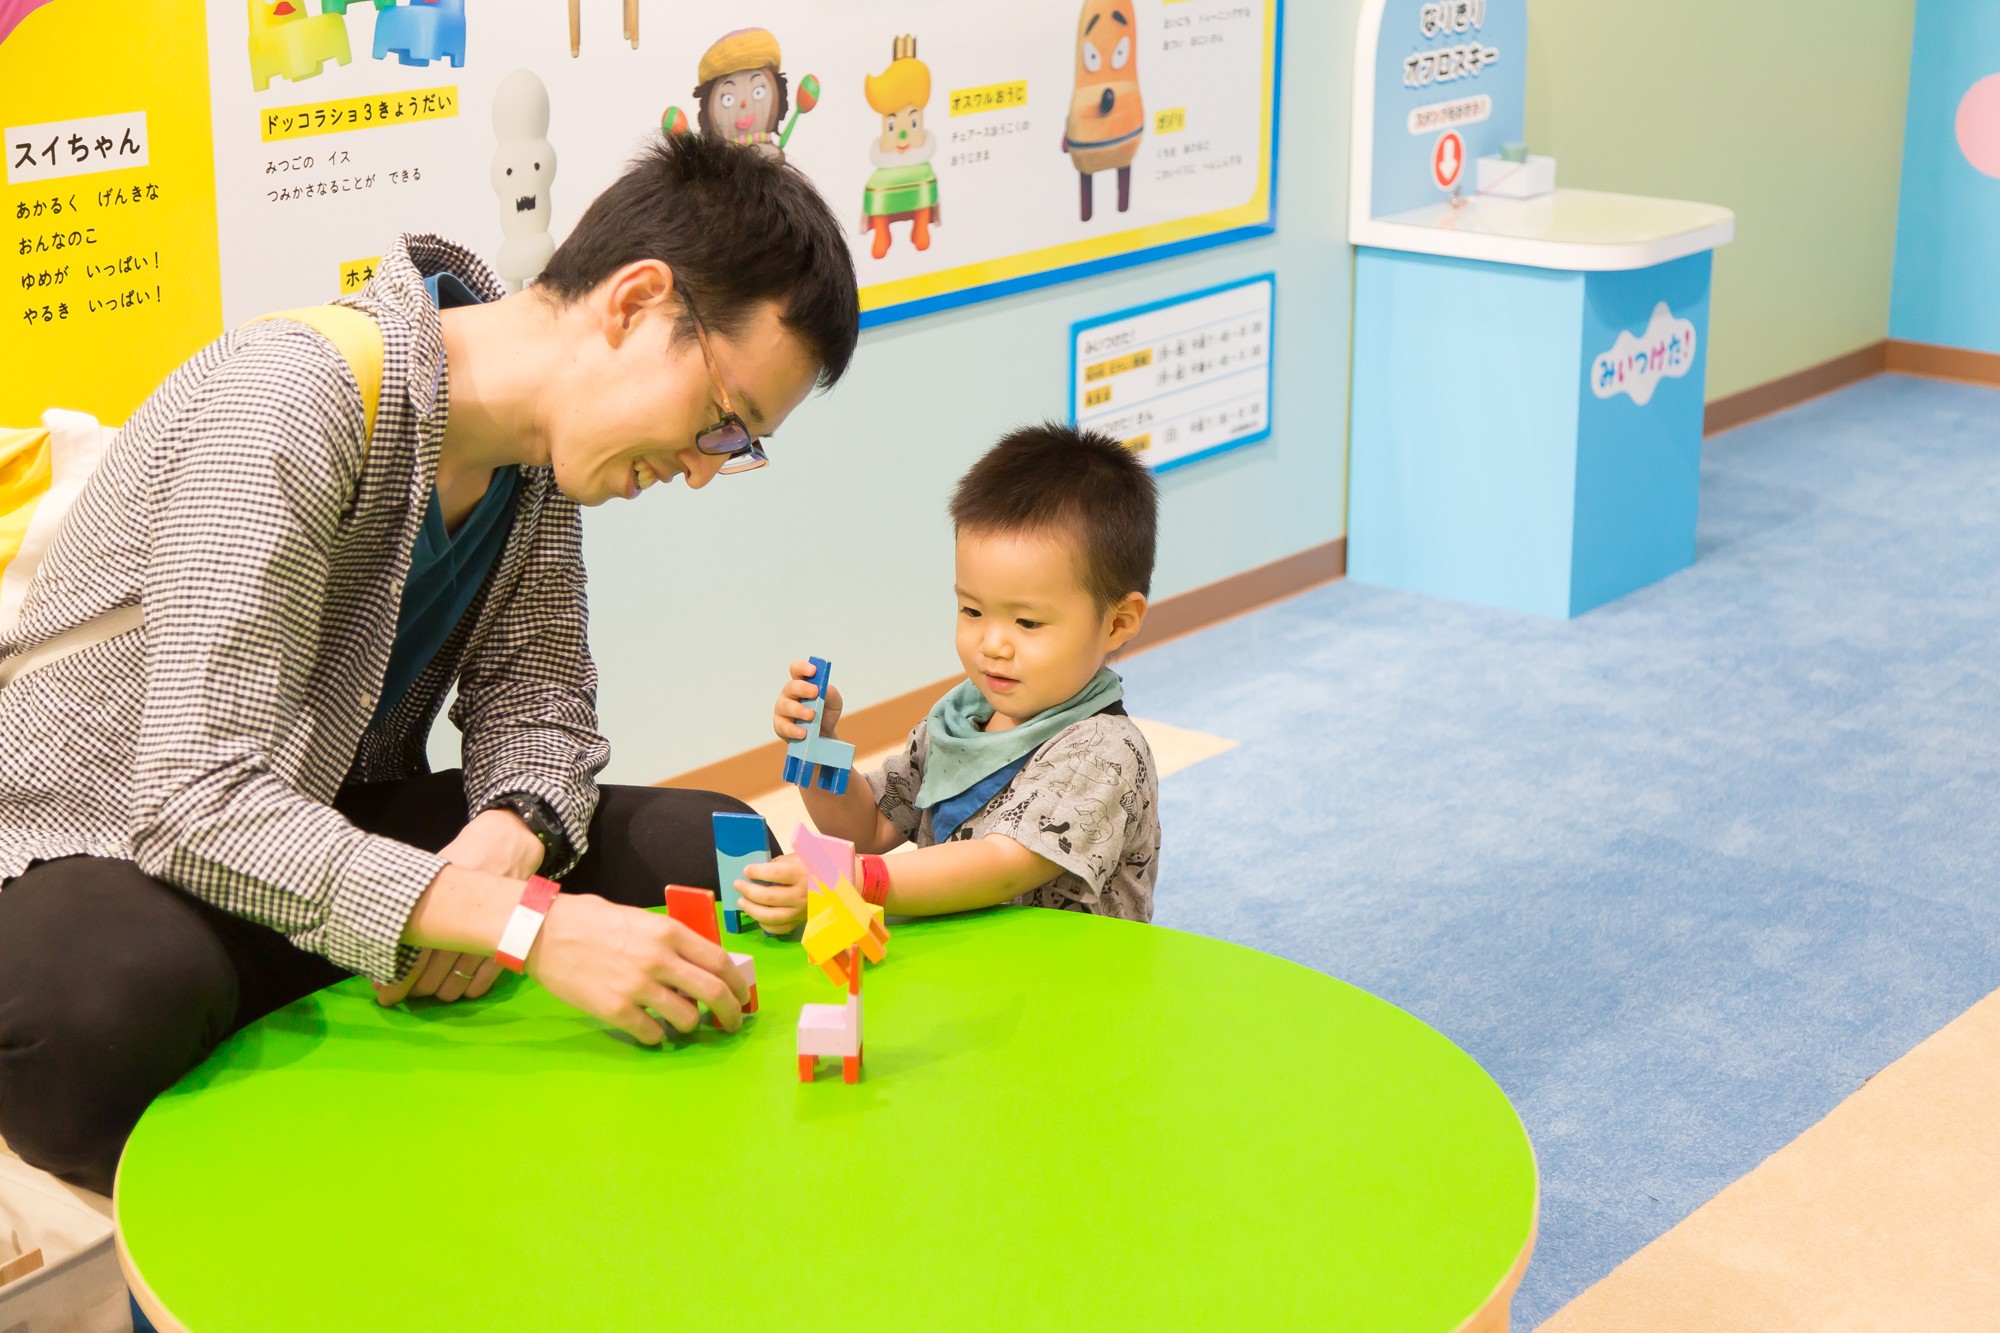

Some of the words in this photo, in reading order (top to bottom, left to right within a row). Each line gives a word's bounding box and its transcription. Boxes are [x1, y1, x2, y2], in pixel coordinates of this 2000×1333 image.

[1405, 46, 1497, 86] オフロスキー
[267, 94, 452, 135] ドッコラショ3きょうだい
[952, 87, 1025, 110] オスワルおうじ
[15, 128, 140, 168] スイちゃん
[265, 156, 314, 174] みつごの
[328, 151, 351, 166] イス
[16, 194, 78, 219] あかるく
[98, 183, 159, 207] げんきな
[267, 174, 376, 202] つみかさなることが
[389, 168, 421, 184] できる
[19, 228, 98, 255] おんなのこ
[21, 265, 70, 290] ゆめが
[86, 251, 159, 278] いっぱい！
[23, 302, 70, 325] やるき
[88, 285, 161, 312] いっぱい！
[1600, 329, 1690, 388] みいつけた！
